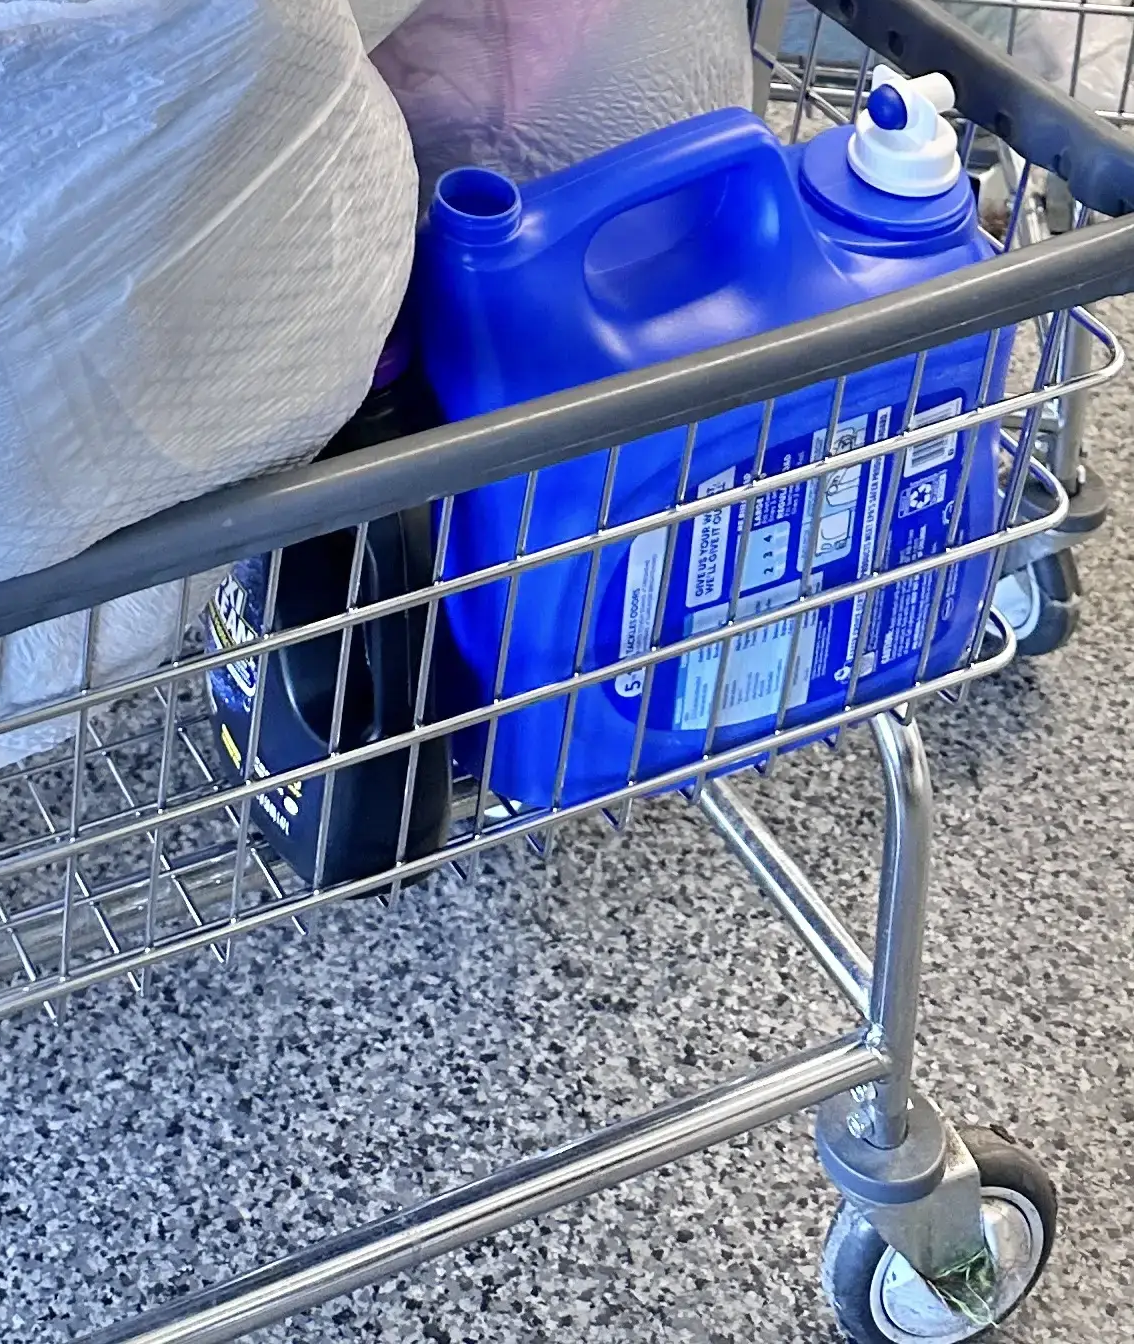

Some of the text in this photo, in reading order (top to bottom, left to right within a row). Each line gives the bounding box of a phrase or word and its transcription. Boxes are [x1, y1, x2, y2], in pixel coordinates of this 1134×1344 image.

[700, 529, 710, 555] YOUR
[708, 543, 717, 562] GIVE
[698, 557, 707, 572] US
[695, 573, 706, 597] GIVE
